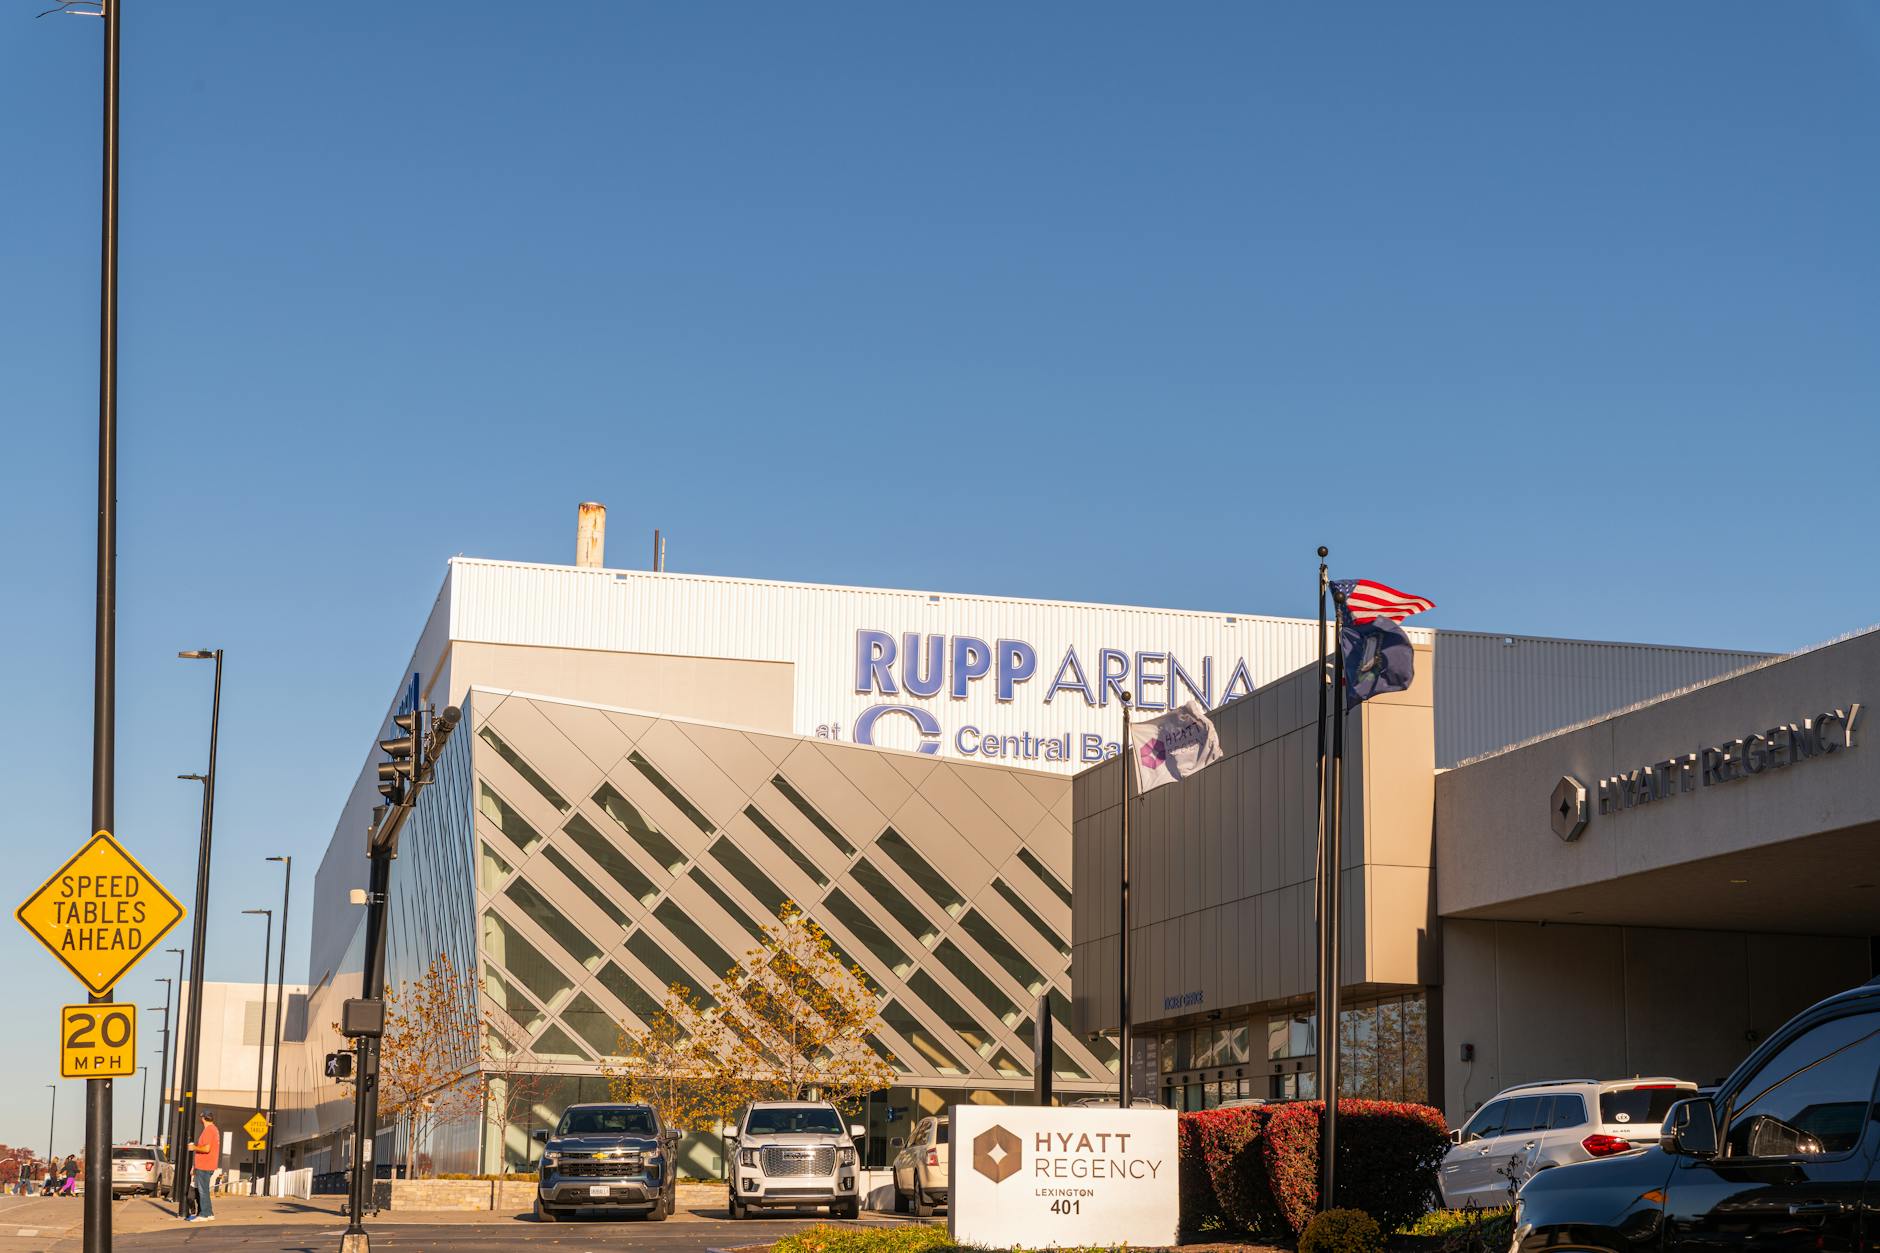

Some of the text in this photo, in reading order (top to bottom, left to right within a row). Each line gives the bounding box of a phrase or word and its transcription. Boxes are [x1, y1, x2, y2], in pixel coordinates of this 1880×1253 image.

[855, 628, 1257, 711] RUPP ARENA
[815, 722, 841, 741] at
[955, 725, 1071, 762] Central
[1081, 732, 1133, 762] Ba
[1165, 722, 1200, 744] HYATT
[1598, 703, 1864, 816] HYATT REGENCY
[60, 875, 139, 898] SPEED
[53, 901, 146, 924] TABLES
[61, 928, 142, 951] AHEAD
[66, 1012, 131, 1049] 20
[75, 1056, 121, 1070] MPH
[1035, 1132, 1131, 1153] HYATT
[1035, 1158, 1162, 1179] REGENCY
[1035, 1188, 1094, 1197] LEXINGTON
[1050, 1199, 1080, 1214] 401
